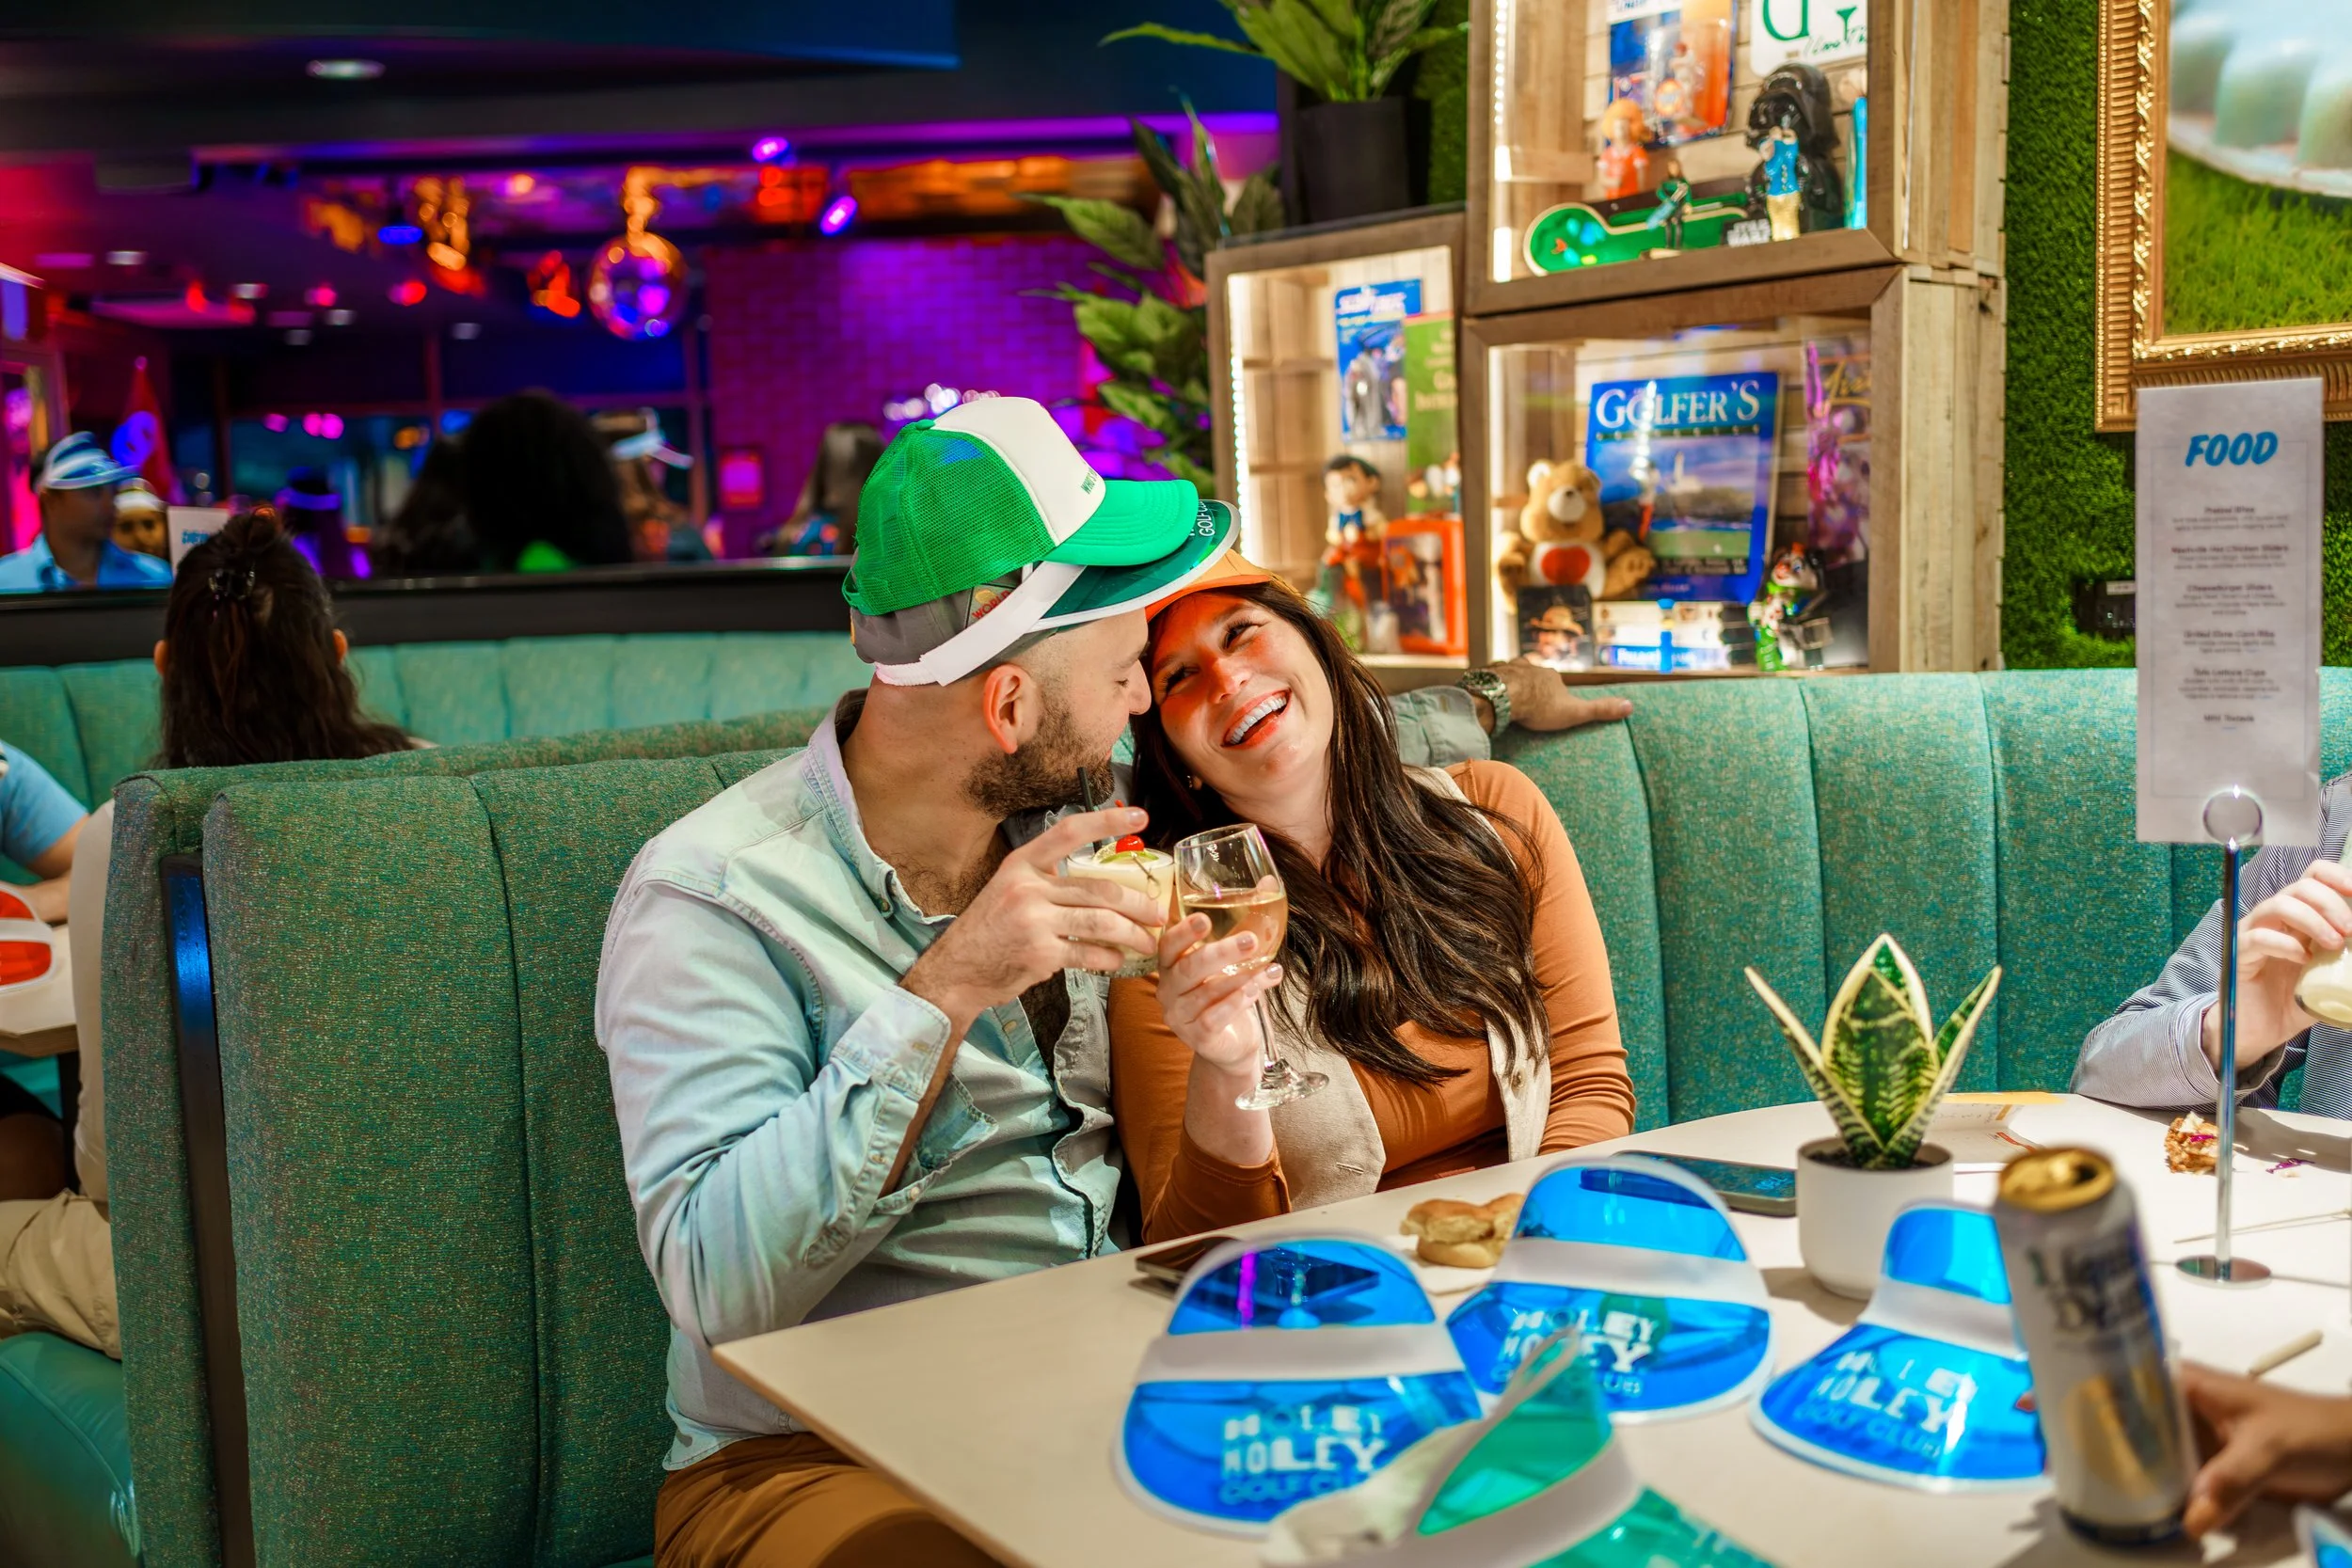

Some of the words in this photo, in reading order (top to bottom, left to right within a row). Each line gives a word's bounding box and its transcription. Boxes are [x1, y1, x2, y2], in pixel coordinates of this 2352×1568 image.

[1596, 380, 1759, 429] GOLFER'S
[2185, 432, 2279, 467] FOOD
[1197, 514, 1216, 536] GOLF
[972, 590, 1010, 620] WORLD
